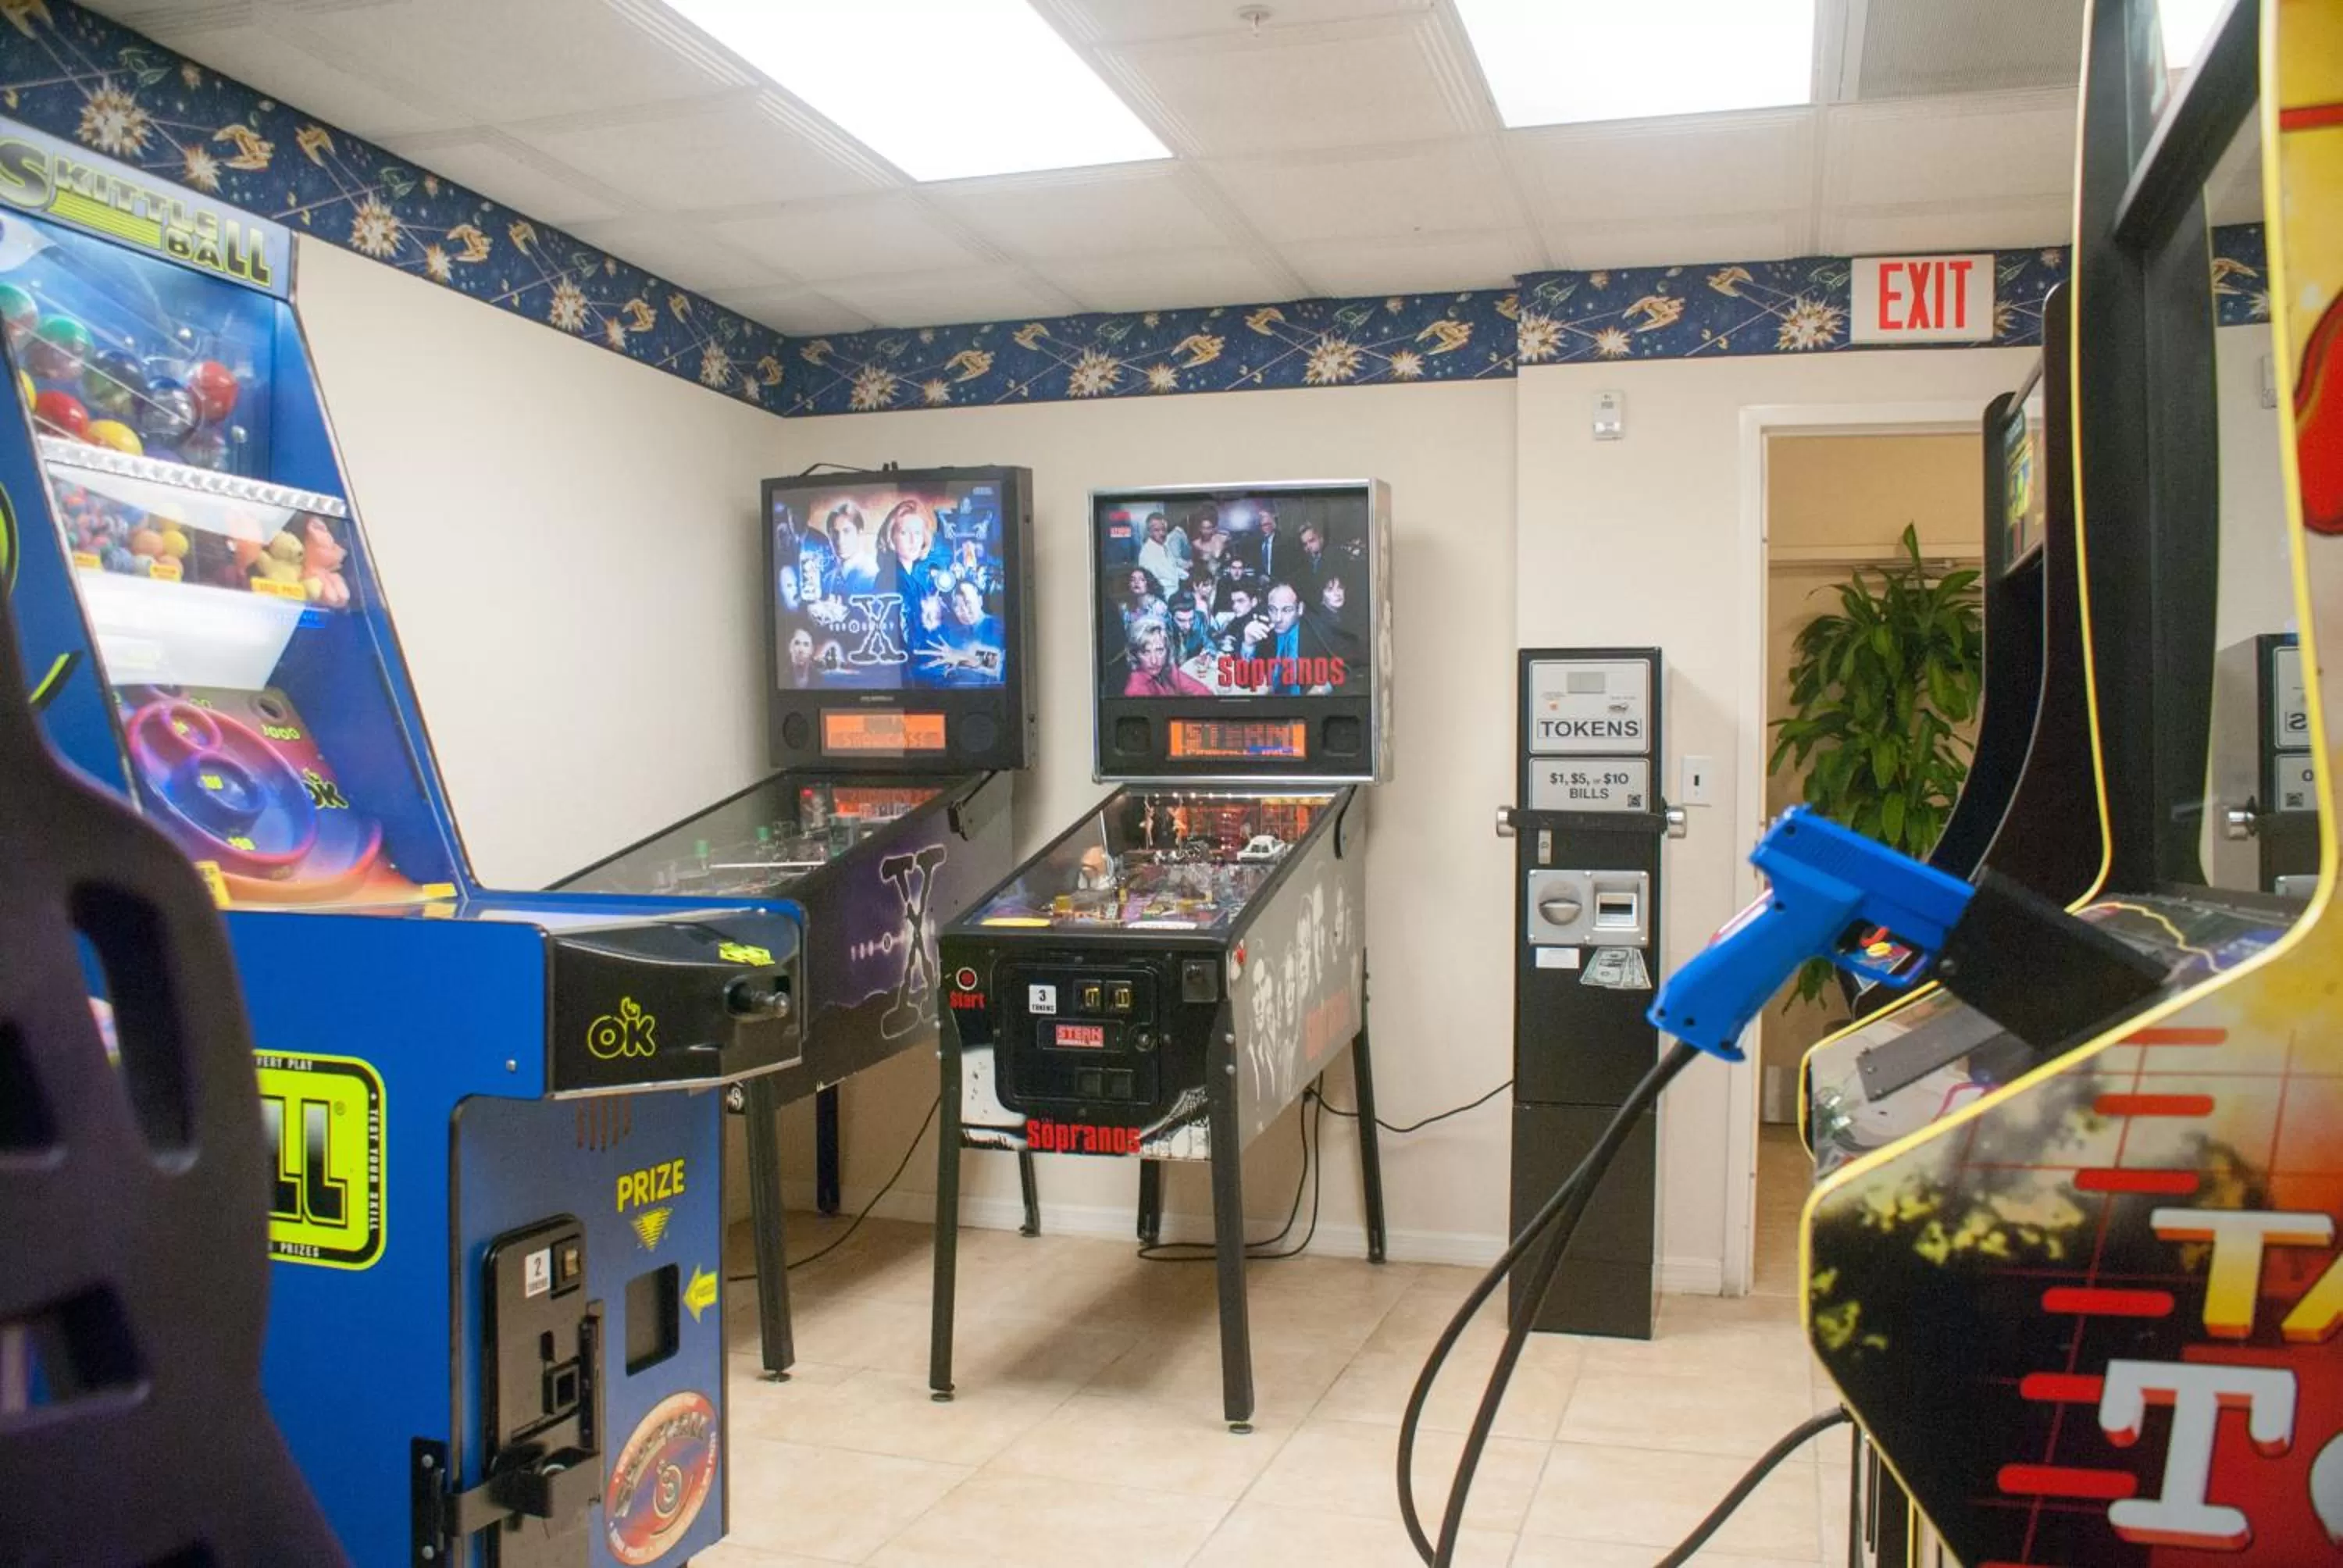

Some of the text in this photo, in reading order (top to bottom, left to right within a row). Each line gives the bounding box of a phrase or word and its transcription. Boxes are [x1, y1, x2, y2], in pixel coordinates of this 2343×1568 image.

[164, 218, 272, 288] BALL
[1878, 261, 1974, 330] EXIT
[1218, 657, 1346, 693] Sopranos
[1541, 721, 1639, 736] TOKENS
[1603, 772, 1629, 785] $10
[1569, 788, 1610, 799] BILLS
[950, 989, 985, 1010] Start
[1038, 989, 1047, 1002] 3
[587, 1014, 656, 1059] OK
[1057, 1027, 1103, 1042] STERN
[256, 1056, 313, 1071] VERY PLAY
[1026, 1119, 1142, 1154] Sopranos
[369, 1109, 380, 1231] TEST YOUR SKILL
[615, 1158, 686, 1213] PRIZE
[280, 1242, 320, 1258] PRIZES
[533, 1257, 543, 1277] 2
